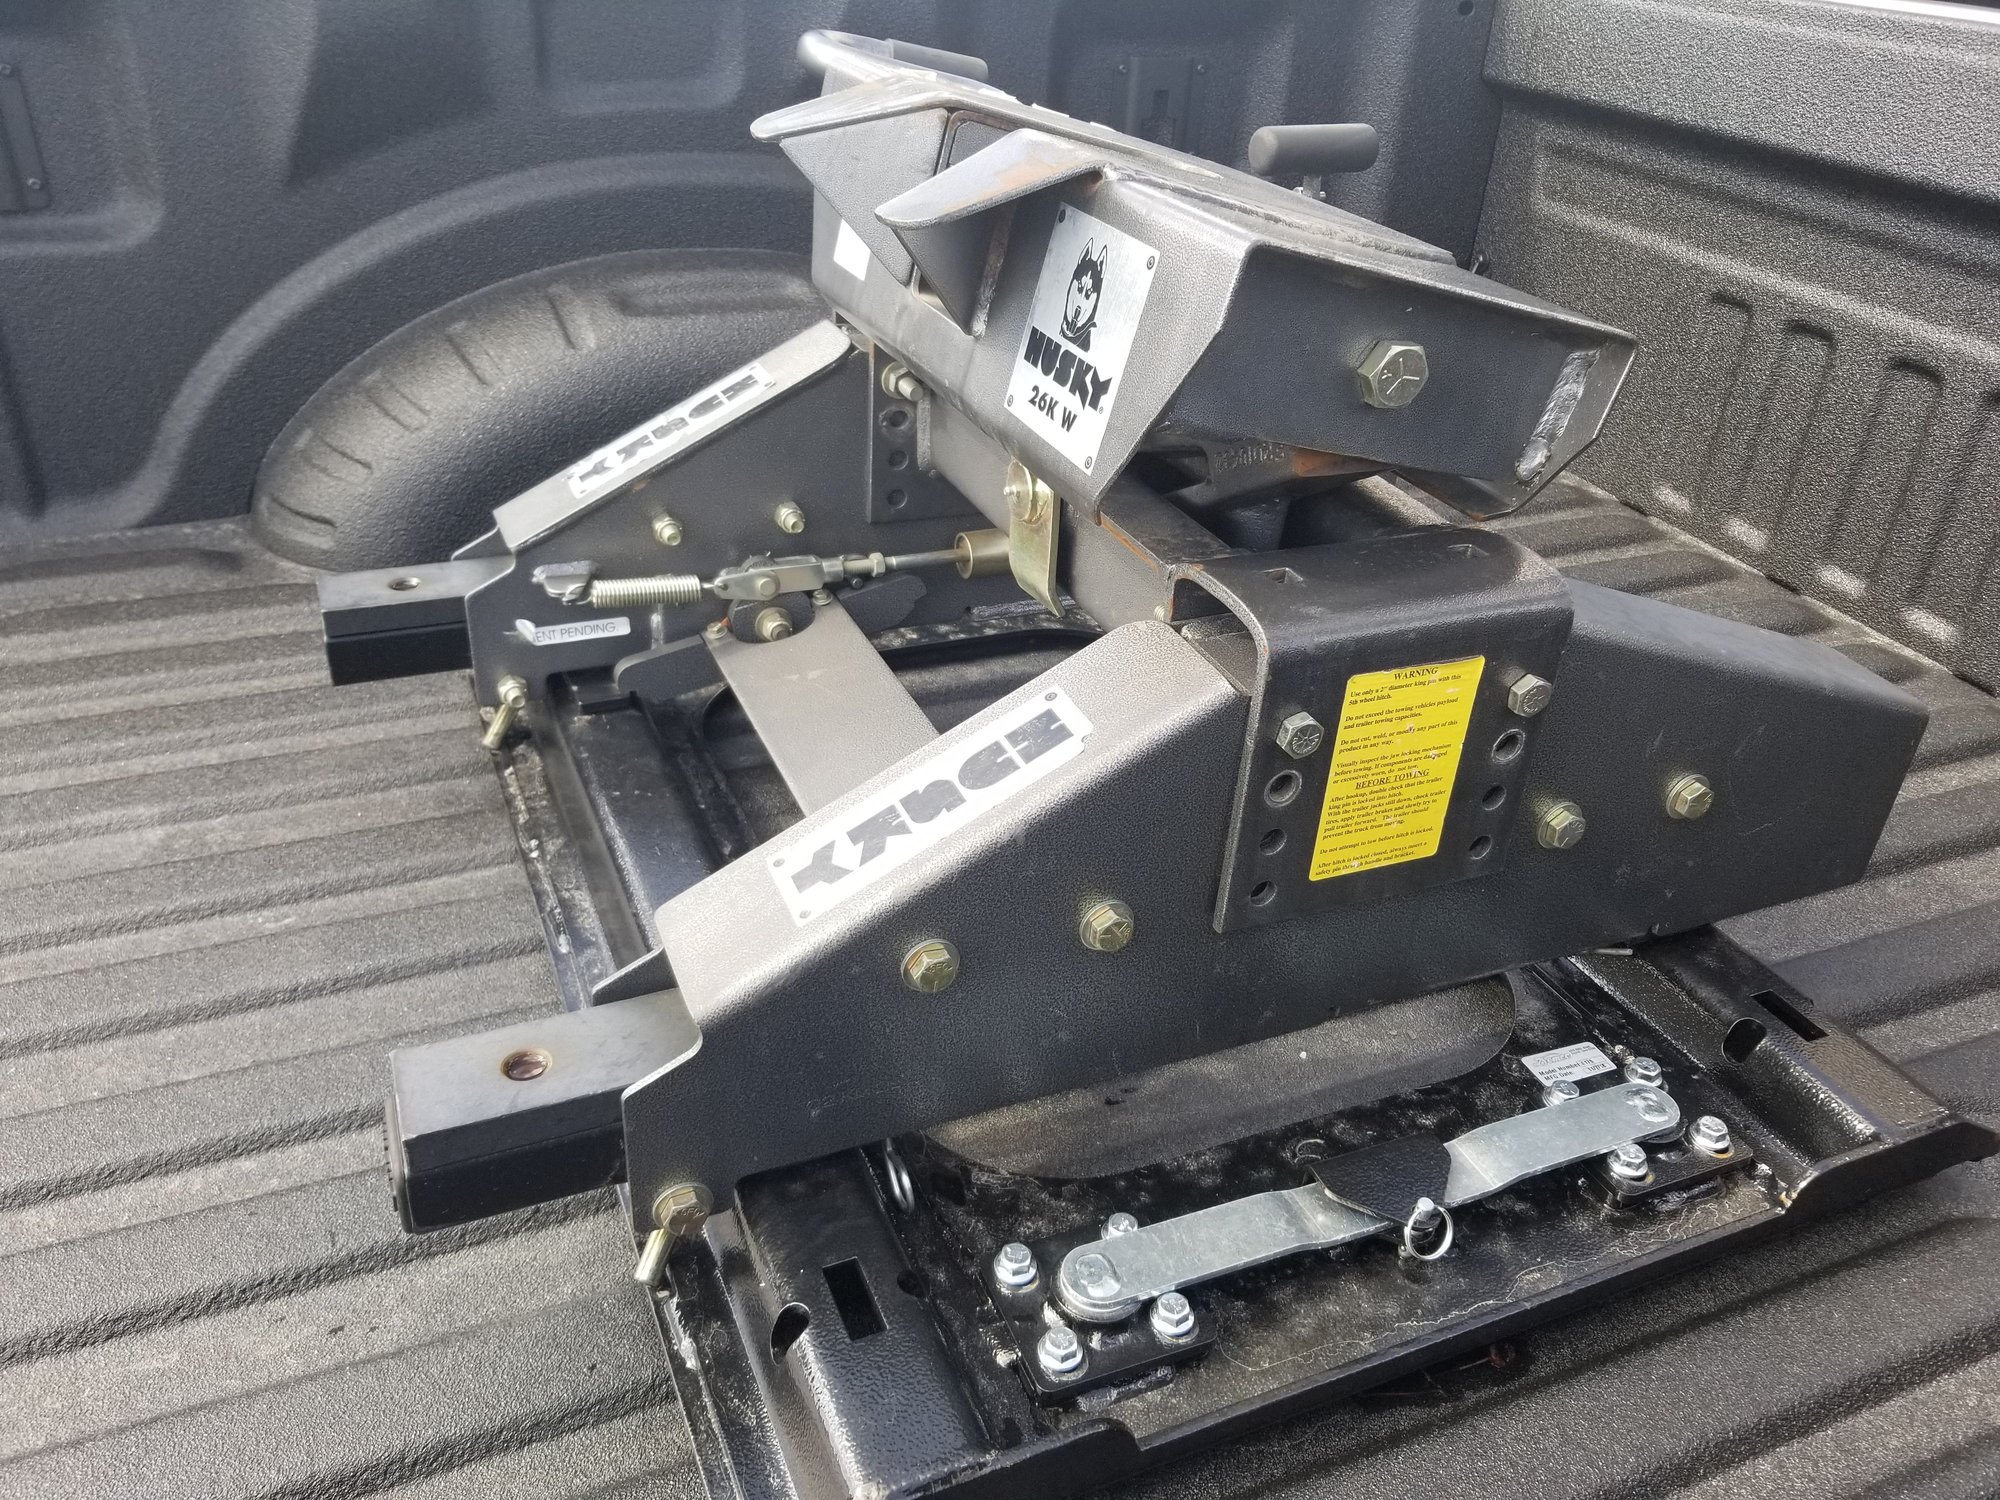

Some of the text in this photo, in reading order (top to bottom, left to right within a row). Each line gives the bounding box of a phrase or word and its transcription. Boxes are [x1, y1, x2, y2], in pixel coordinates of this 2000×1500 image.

[1024, 325, 1112, 412] HUSKY
[1028, 385, 1077, 432] 26K W
[560, 622, 616, 638] PENDING
[1394, 667, 1438, 680] WARNING
[1362, 689, 1373, 697] only
[1388, 682, 1413, 690] diameter
[1360, 696, 1375, 704] wheel
[1366, 710, 1384, 718] exceed
[1395, 705, 1413, 713] towing
[1415, 701, 1436, 709] vehicles
[1437, 698, 1458, 707] payload
[1375, 716, 1393, 725] towing
[1394, 712, 1422, 722] capacities.
[1428, 723, 1440, 731] part
[1336, 760, 1358, 768] Visually
[1360, 756, 1378, 765] inspect
[1401, 749, 1420, 758] locking
[1422, 744, 1451, 752] mechanism
[1338, 744, 1361, 754] product
[1381, 758, 1412, 769] components
[1424, 751, 1448, 760] daged
[1340, 772, 1369, 783] excessively
[1355, 769, 1430, 790] BEFORE TOWING
[1426, 776, 1443, 784] trailer
[791, 708, 1074, 894] HUSKY
[1352, 805, 1369, 814] trailer
[1370, 802, 1384, 811] jacks
[1414, 792, 1428, 800] check
[1430, 789, 1446, 798] trailer
[1358, 796, 1375, 804] locked
[1324, 826, 1335, 834] pull
[1336, 823, 1354, 831] trailer
[1394, 811, 1410, 819] trailer
[1411, 806, 1429, 814] should
[1341, 815, 1355, 824] apply
[1356, 811, 1373, 819] trailer
[1375, 807, 1392, 816] brakes
[1405, 802, 1421, 811] slowly
[1322, 832, 1343, 841] prevent
[1370, 823, 1383, 831] from
[1339, 842, 1360, 852] attempt
[1378, 835, 1394, 844] before
[1415, 826, 1434, 834] locked.
[1353, 853, 1369, 862] locked
[1390, 846, 1407, 855] always
[1408, 842, 1422, 850] insert
[1539, 1067, 1556, 1076] Model
